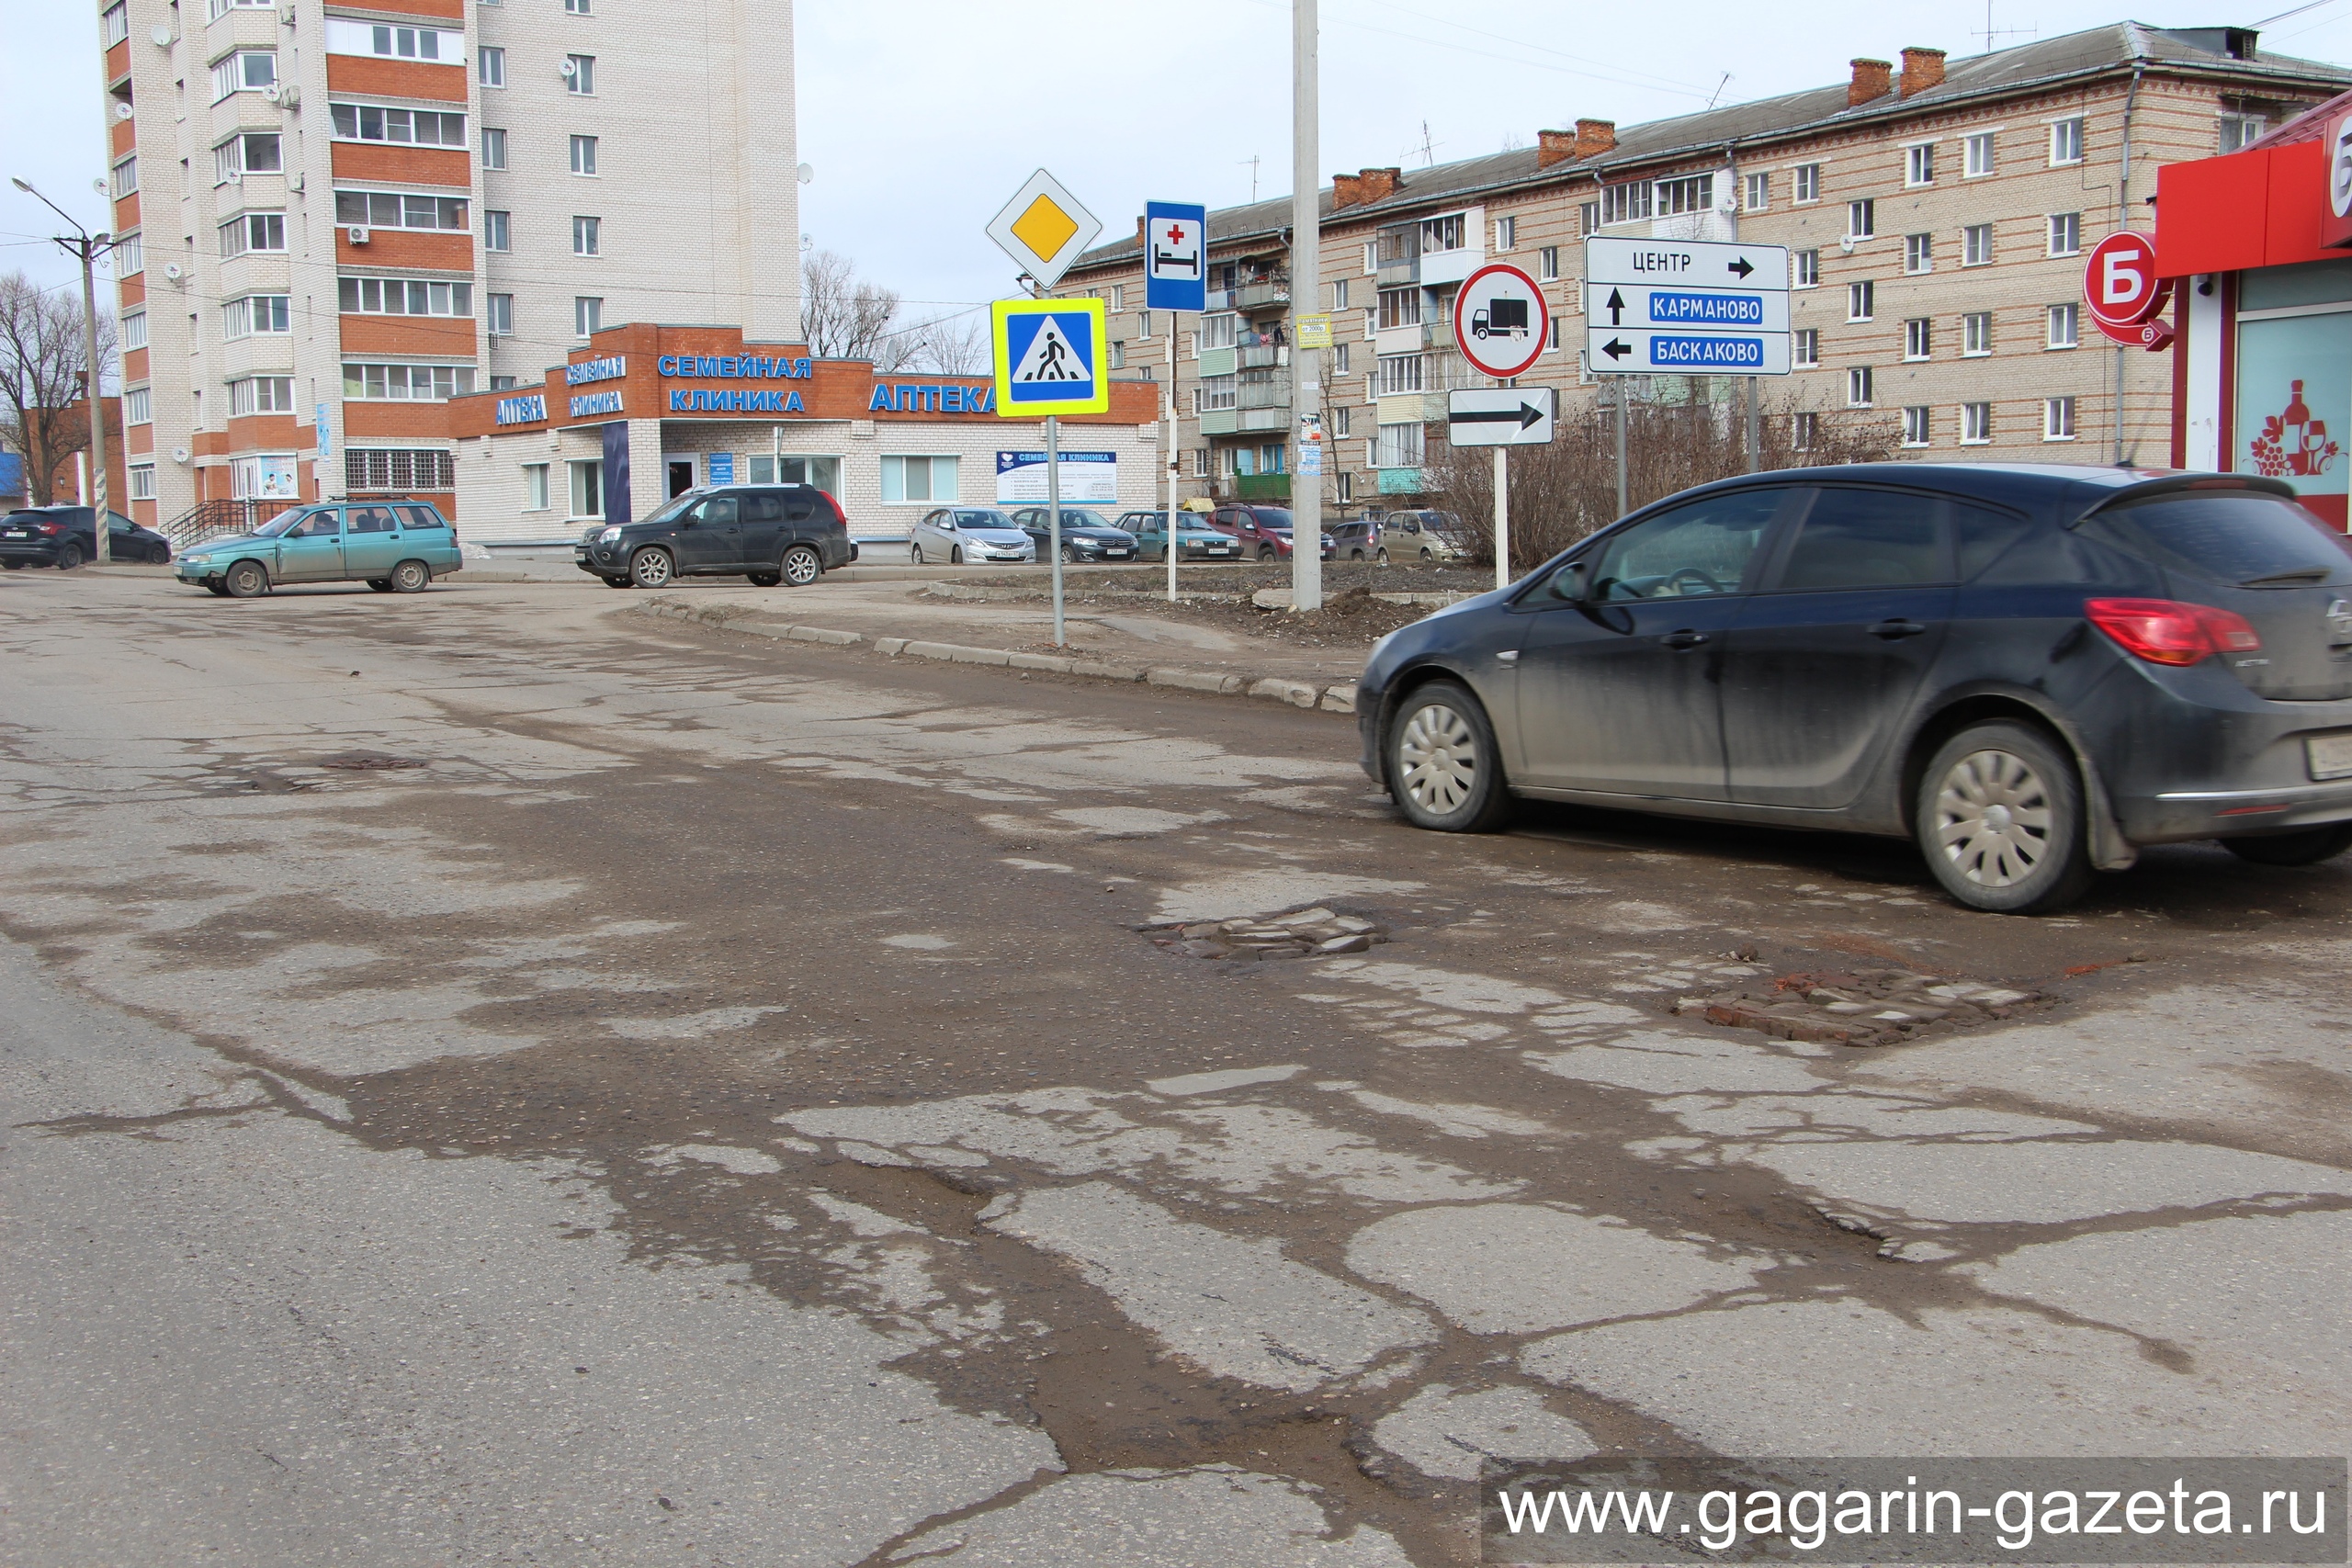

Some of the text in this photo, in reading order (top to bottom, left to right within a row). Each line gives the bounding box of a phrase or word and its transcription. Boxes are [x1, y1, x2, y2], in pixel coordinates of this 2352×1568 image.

[1633, 252, 1691, 274] ЦЕНТР
[2103, 250, 2143, 304] Б
[1653, 297, 1760, 321] КАРМАНОВО
[2143, 330, 2153, 340] Б
[1657, 341, 1758, 363] БАСКАКОВО
[565, 355, 627, 386] СЕМЕЙНАЯ
[657, 352, 812, 379] СЕМЕЙНАЯ
[495, 395, 548, 425] АПТЕКА
[570, 390, 625, 417] КЛИНИКА
[669, 389, 805, 412] КЛИНИКА
[1018, 453, 1067, 461] СЕМЕЙАЯ
